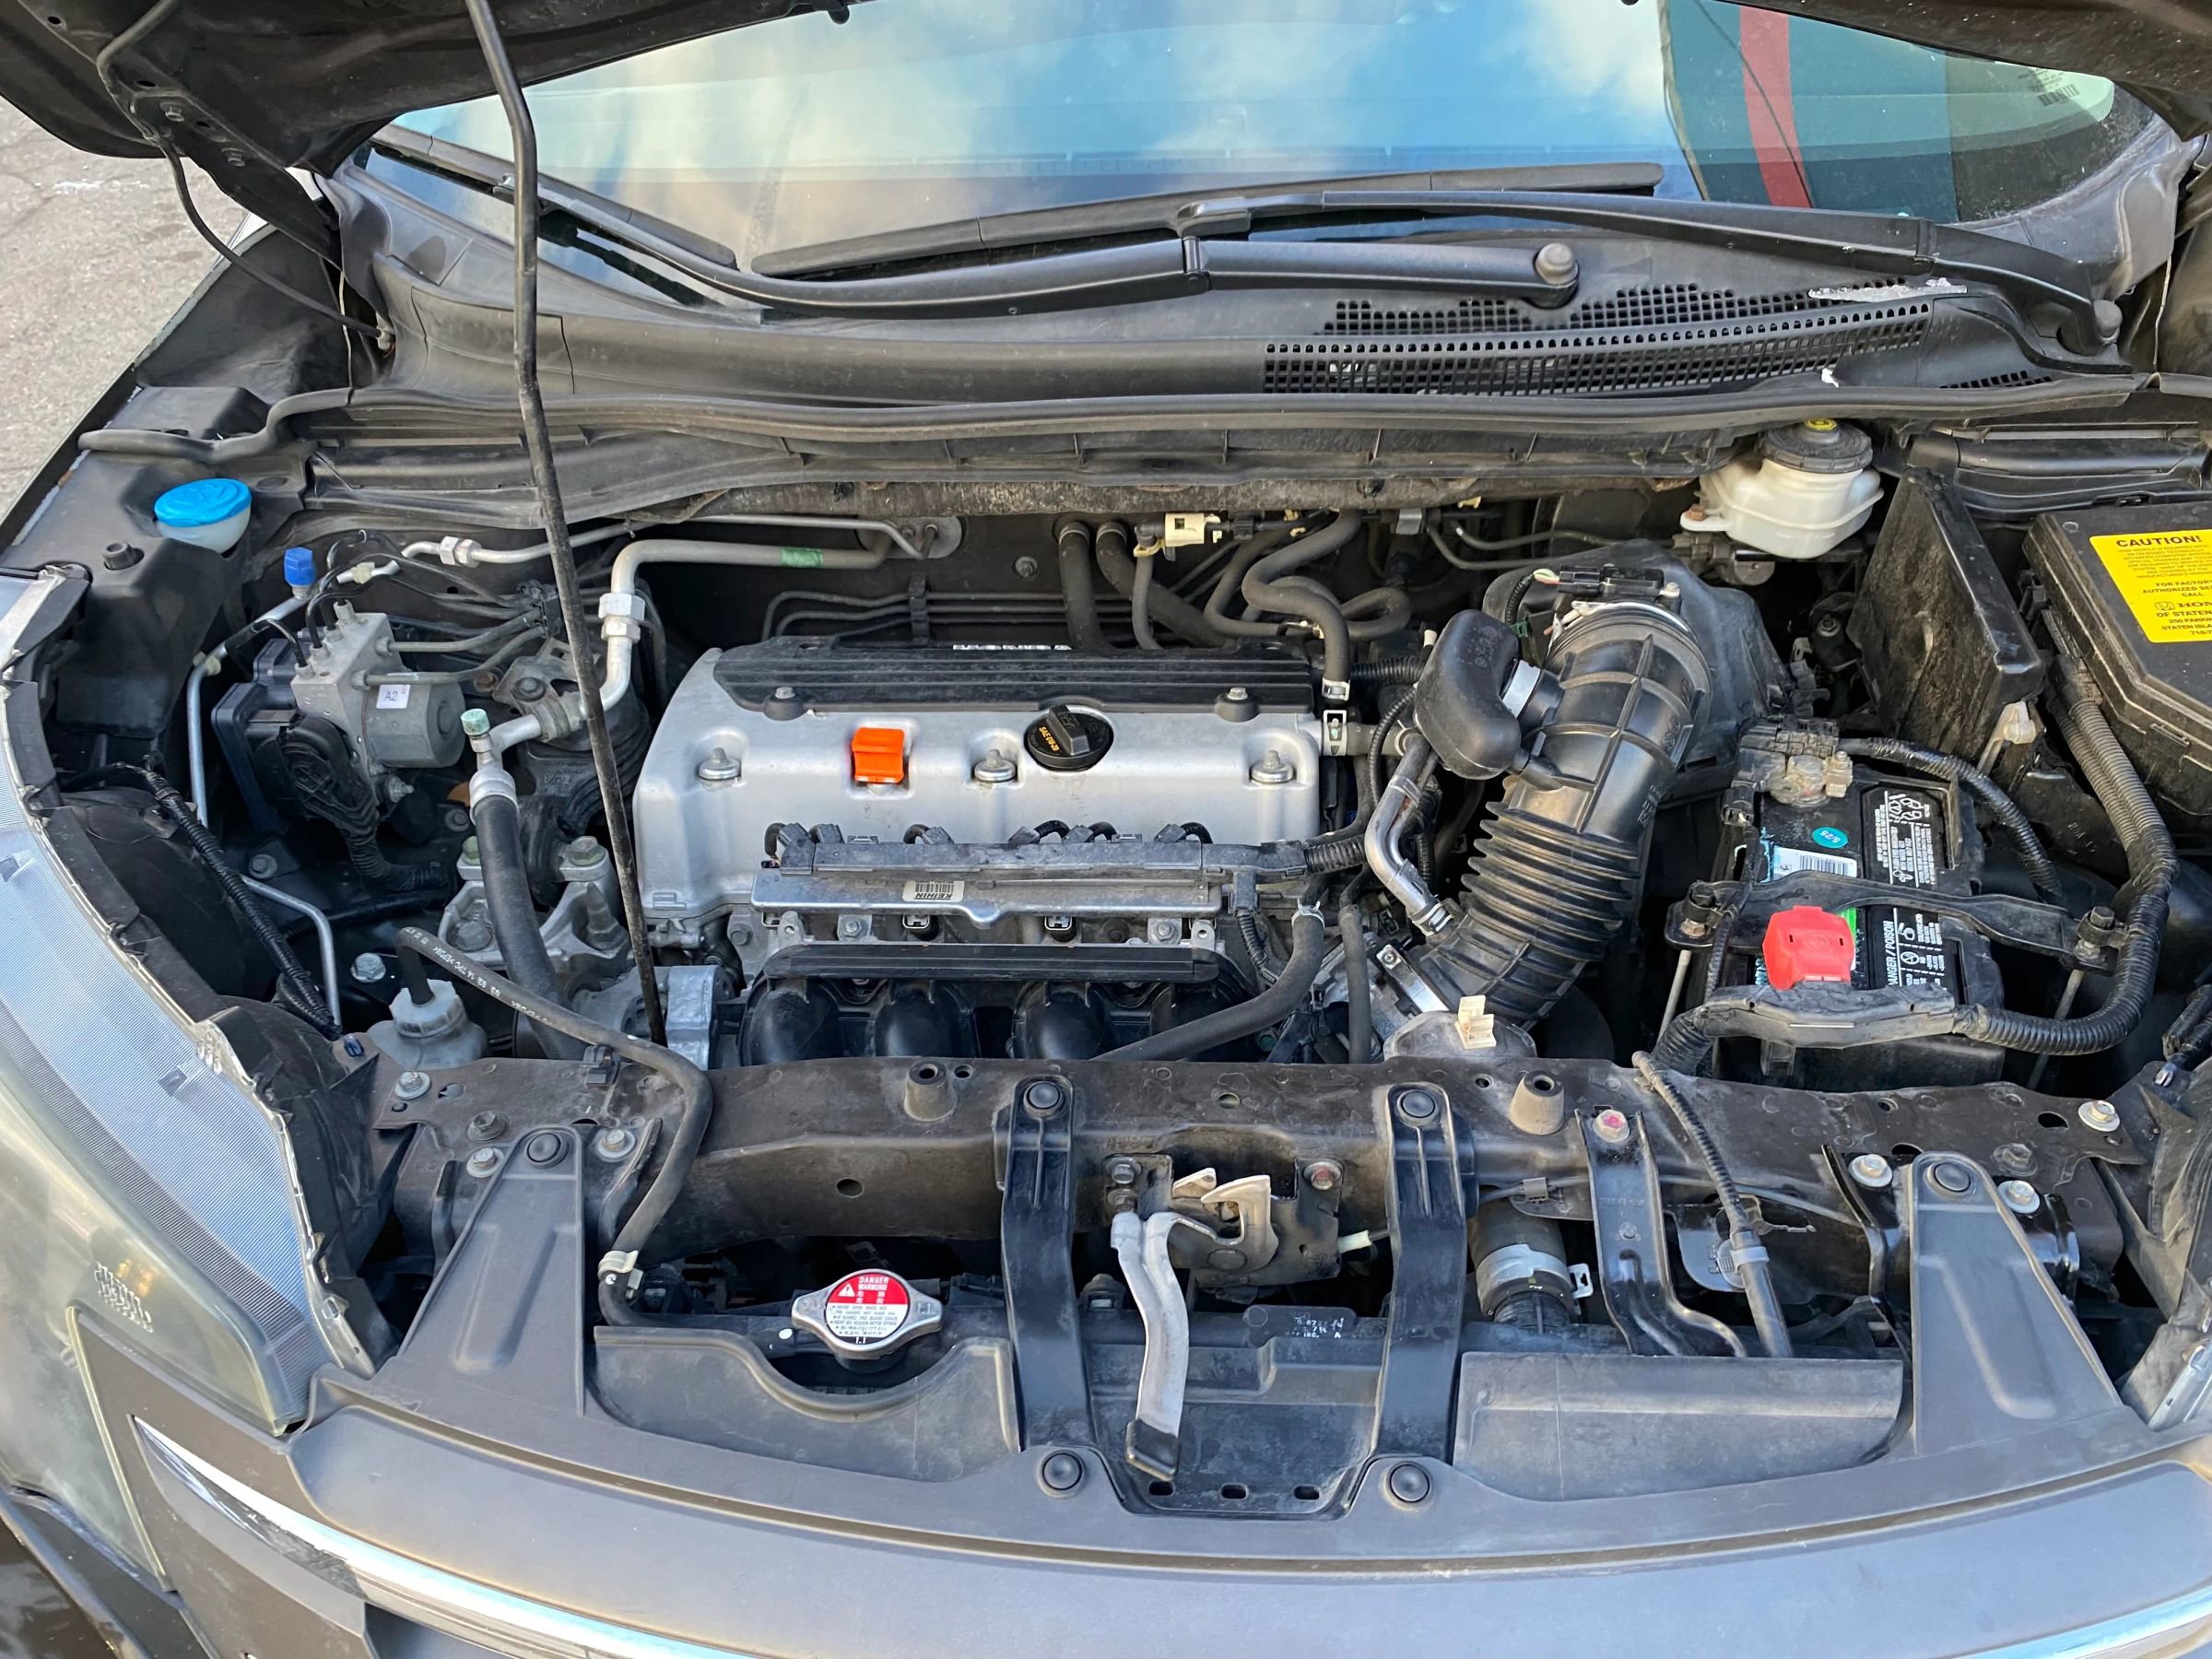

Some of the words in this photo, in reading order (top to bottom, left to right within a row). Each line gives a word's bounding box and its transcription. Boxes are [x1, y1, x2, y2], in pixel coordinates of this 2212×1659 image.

[2116, 535, 2202, 547] CAUTION!
[384, 690, 398, 701] A2
[1039, 726, 1052, 738] SAE
[913, 892, 953, 900] KEIHIN
[1882, 920, 1897, 950] POISON
[858, 1276, 890, 1284] DANGER
[855, 1336, 867, 1345] 1.1
